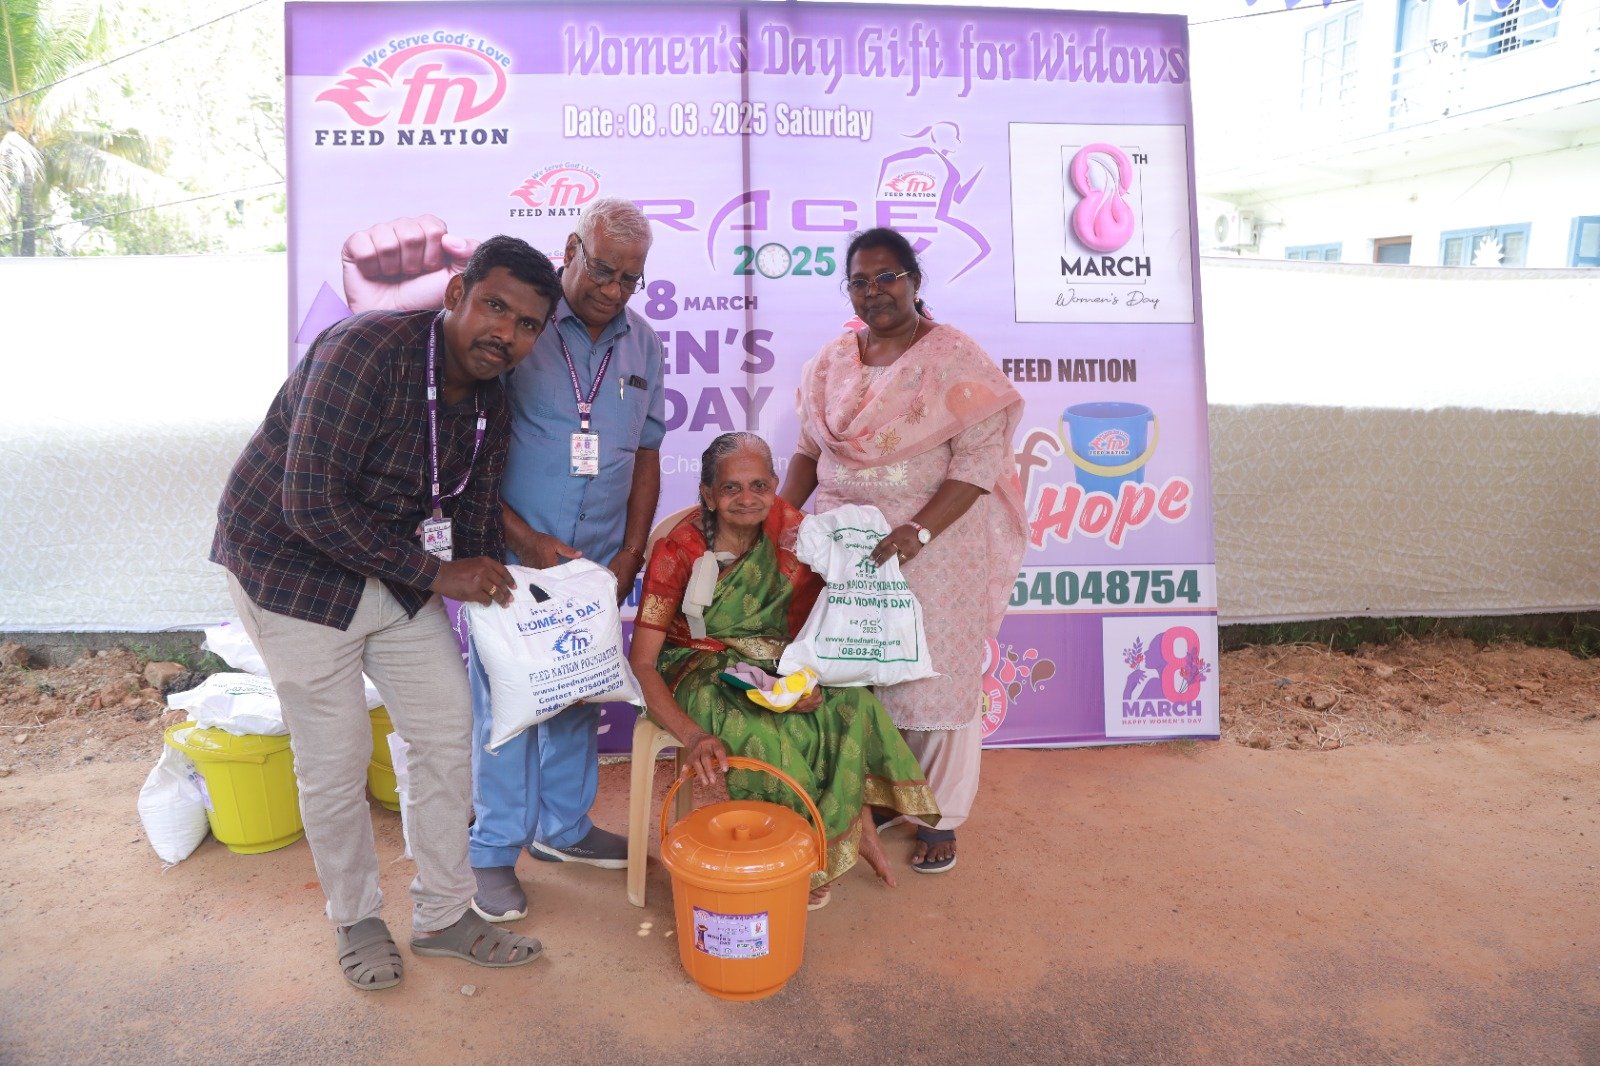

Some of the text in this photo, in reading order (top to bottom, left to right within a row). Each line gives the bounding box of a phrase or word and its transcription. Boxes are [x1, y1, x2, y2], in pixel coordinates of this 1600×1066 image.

[362, 30, 510, 68] We Serve God's Love
[565, 22, 1187, 98] Women's Day Gift for Widows
[776, 104, 872, 141] Saturday
[315, 128, 509, 146] FEED NATION
[1132, 154, 1148, 165] TH
[510, 208, 581, 217] FEED NATI
[1061, 256, 1152, 276] MARCH
[645, 280, 758, 320] 8 MARCH
[1126, 290, 1160, 309] Day
[1002, 358, 1137, 382] FEED NATION
[1030, 480, 1190, 546] Hope
[1008, 570, 1201, 606] 54048754
[891, 600, 911, 608] DAY
[539, 691, 572, 704] Contact
[1122, 701, 1202, 718] MARCH
